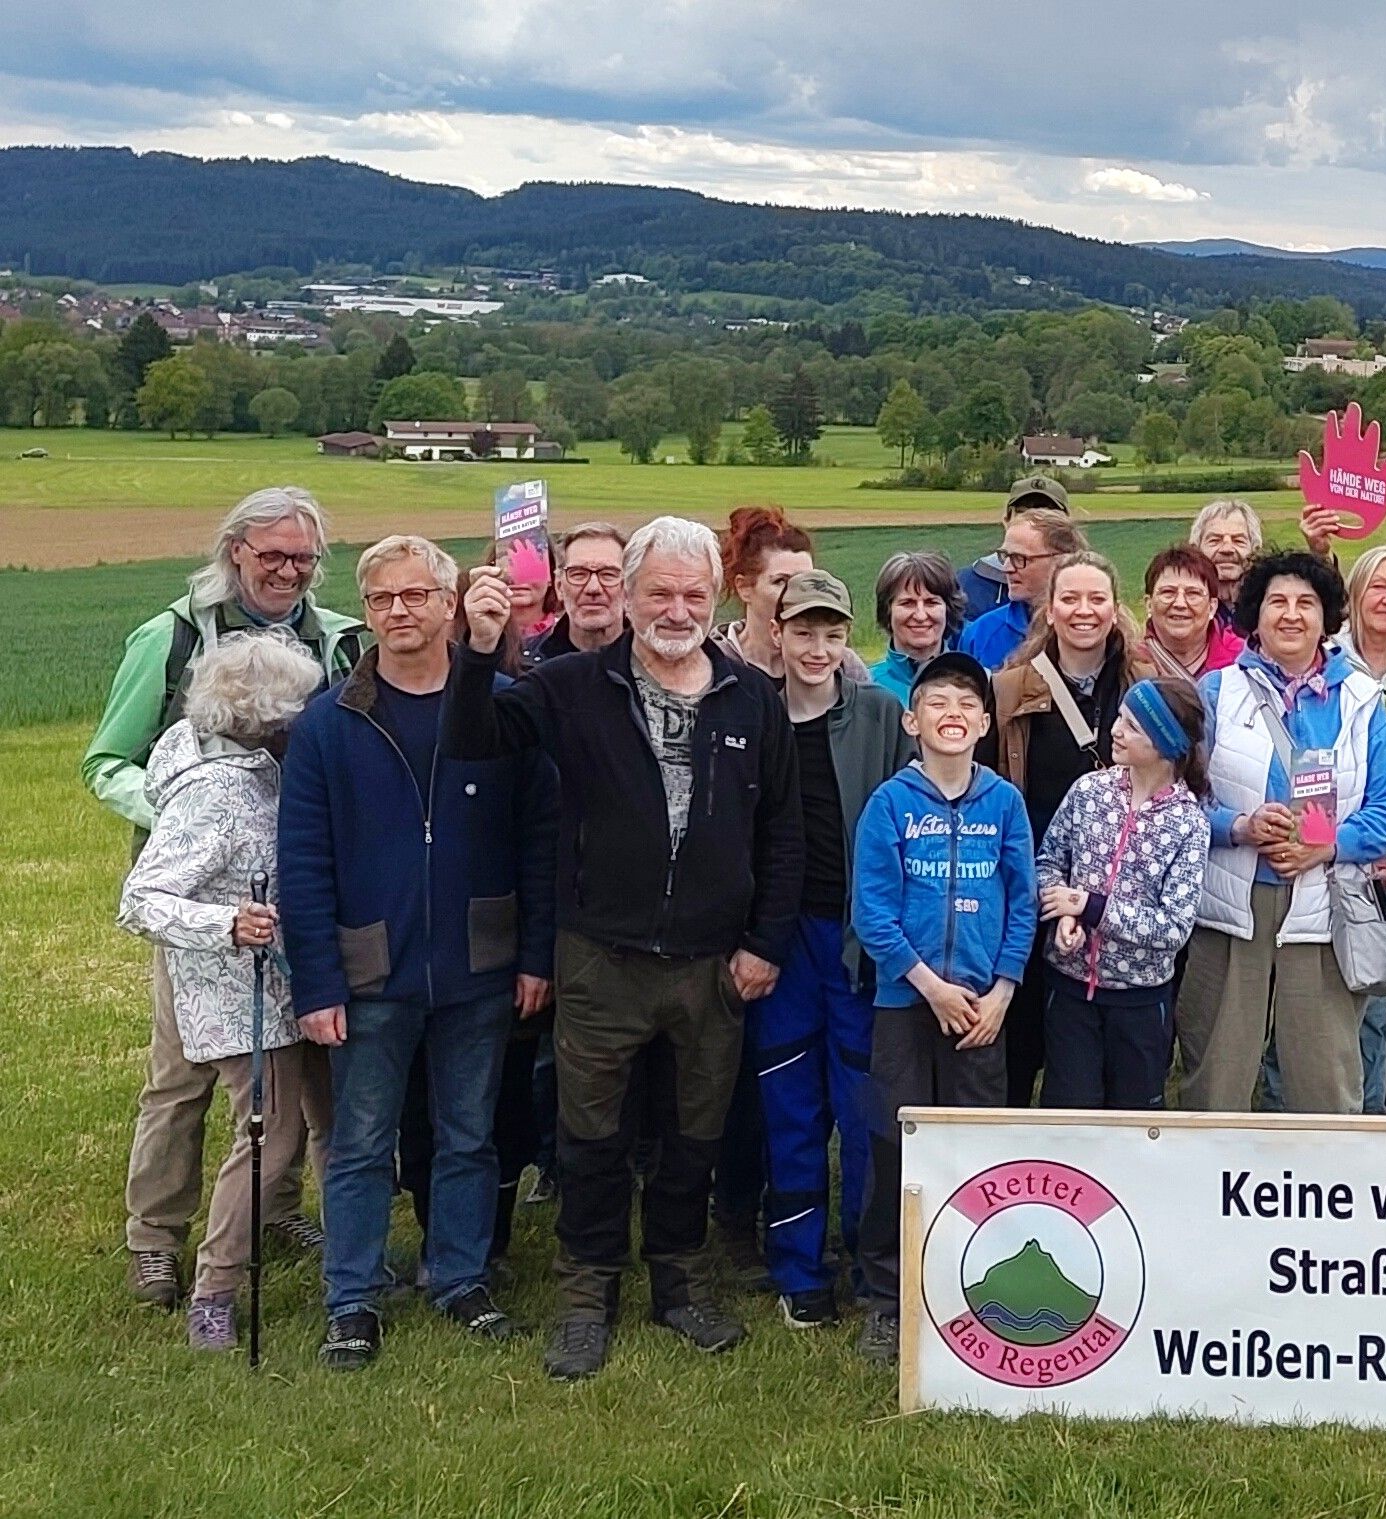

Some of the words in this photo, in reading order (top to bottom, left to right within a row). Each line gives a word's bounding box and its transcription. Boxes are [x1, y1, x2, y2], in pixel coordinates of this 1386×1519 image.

[1329, 468, 1362, 489] HÄNDE
[1364, 477, 1386, 495] WEG
[1330, 483, 1344, 496] VON
[1344, 487, 1359, 499] DER
[1360, 491, 1385, 505] NATUR!
[977, 1172, 1084, 1208] Rettet
[1221, 1170, 1354, 1220] Keine
[949, 1318, 991, 1360] das
[996, 1317, 1119, 1384] Regental
